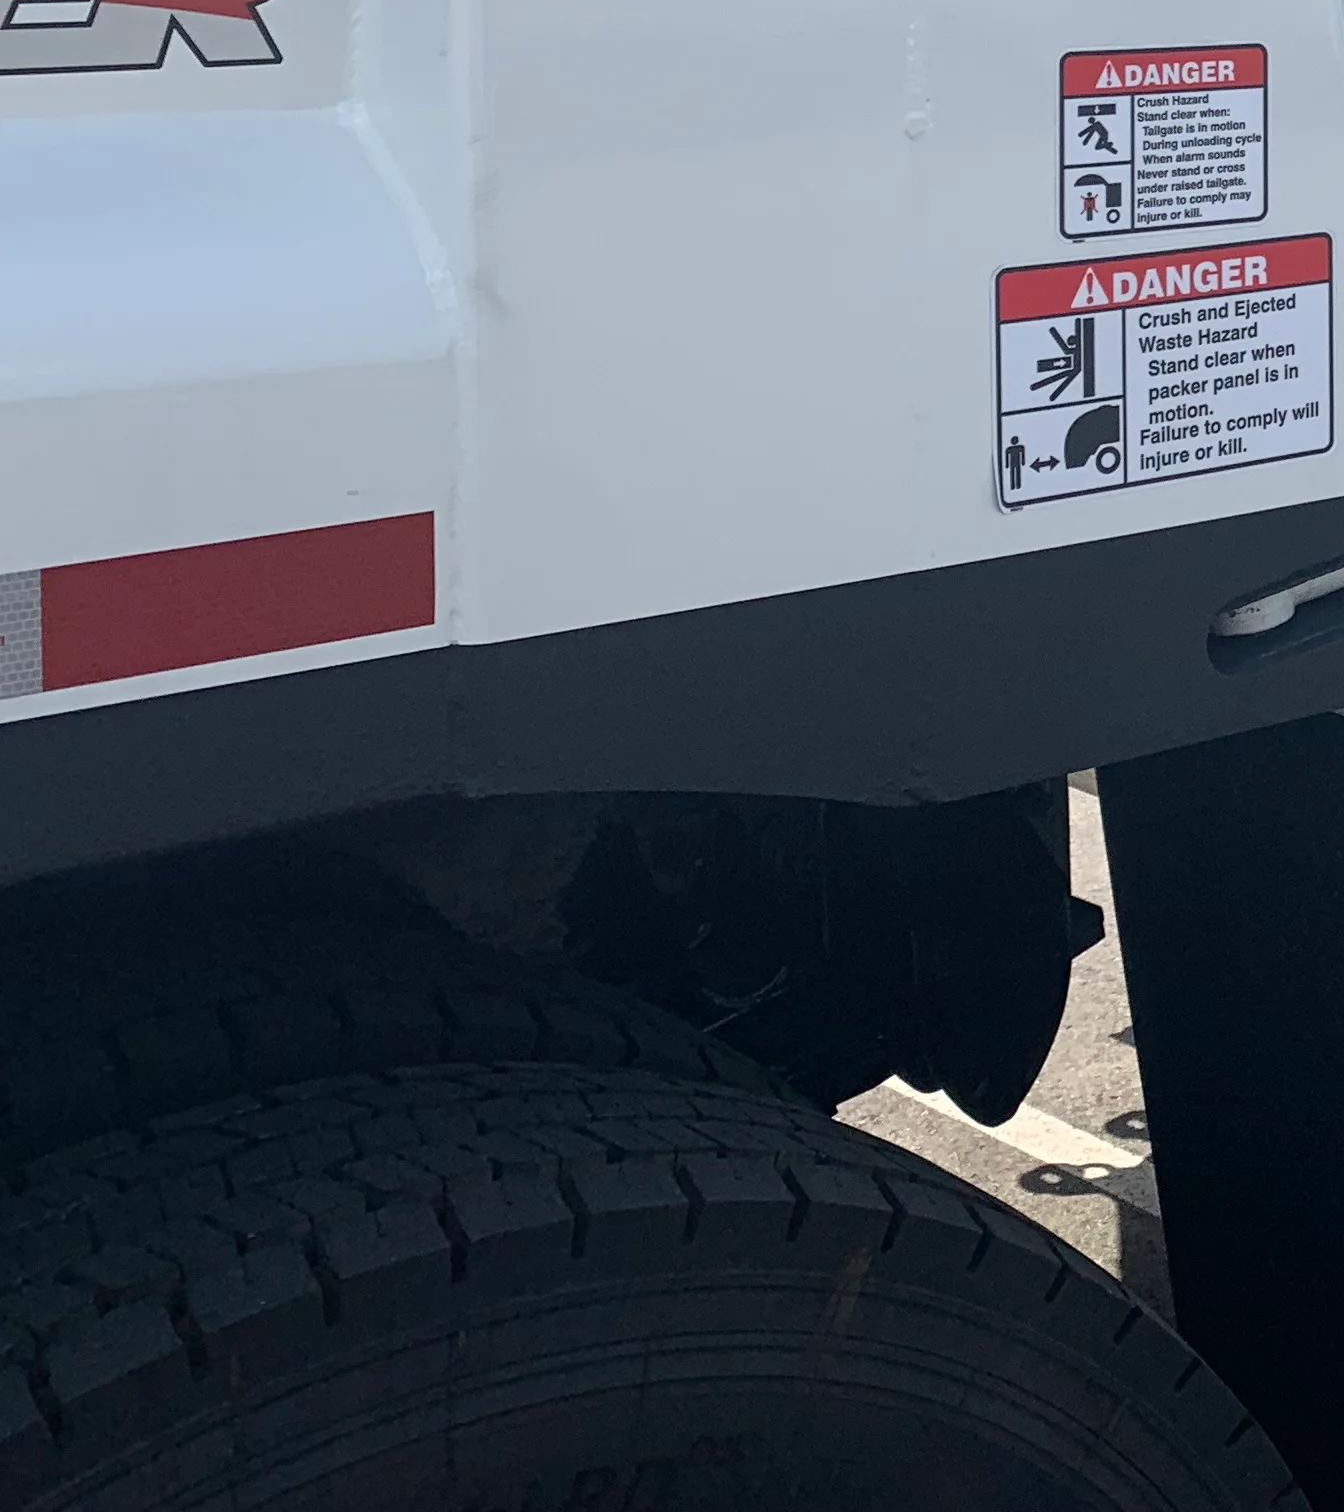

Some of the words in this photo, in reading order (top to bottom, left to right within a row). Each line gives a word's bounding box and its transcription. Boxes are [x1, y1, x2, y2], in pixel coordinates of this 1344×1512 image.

[1124, 59, 1236, 88] DANGER
[1137, 95, 1169, 108] Crush
[1172, 93, 1210, 106] Hazard
[1137, 110, 1168, 123] Stand
[1171, 109, 1197, 120] clear
[1200, 107, 1231, 119] when:
[1142, 124, 1183, 139] Tailgate
[1186, 123, 1196, 134] is
[1198, 122, 1208, 133] in
[1210, 120, 1246, 132] motion
[1143, 138, 1178, 152] During
[1181, 135, 1233, 149] unloading
[1235, 133, 1262, 146] cycle
[1143, 153, 1173, 165] When
[1175, 151, 1205, 163] alarm
[1207, 148, 1246, 161] sounds
[1137, 168, 1169, 180] Never
[1171, 165, 1200, 178] stand
[1203, 165, 1214, 174] or
[1217, 163, 1246, 173] cross
[1137, 182, 1169, 195] under
[1171, 179, 1203, 192] raised
[1206, 175, 1247, 190] tailgate.
[1137, 196, 1173, 209] Failure
[1176, 195, 1187, 205] to
[1189, 191, 1228, 205] comply
[1230, 190, 1252, 202] may
[1137, 210, 1171, 225] injure
[1171, 210, 1182, 220] or
[1184, 207, 1203, 219] kill.
[1112, 255, 1268, 303] DANGER
[1138, 307, 1192, 330] Crush
[1197, 302, 1229, 322] and
[1234, 293, 1296, 319] Ejected
[1138, 331, 1193, 354] Waste
[1198, 322, 1258, 346] Hazard
[1148, 353, 1199, 377] Stand
[1204, 349, 1247, 369] clear
[1251, 343, 1296, 362] when
[1148, 379, 1208, 405] packer
[1213, 368, 1260, 395] panel
[1264, 366, 1279, 384] is
[1284, 363, 1299, 381] in
[1140, 423, 1199, 446] Failure
[1204, 419, 1222, 436] to
[1226, 407, 1287, 430] comply
[1292, 401, 1319, 421] will
[1149, 402, 1214, 425] motion.
[1140, 449, 1190, 472] injure
[1195, 445, 1213, 461] or
[1218, 437, 1247, 457] kill.
